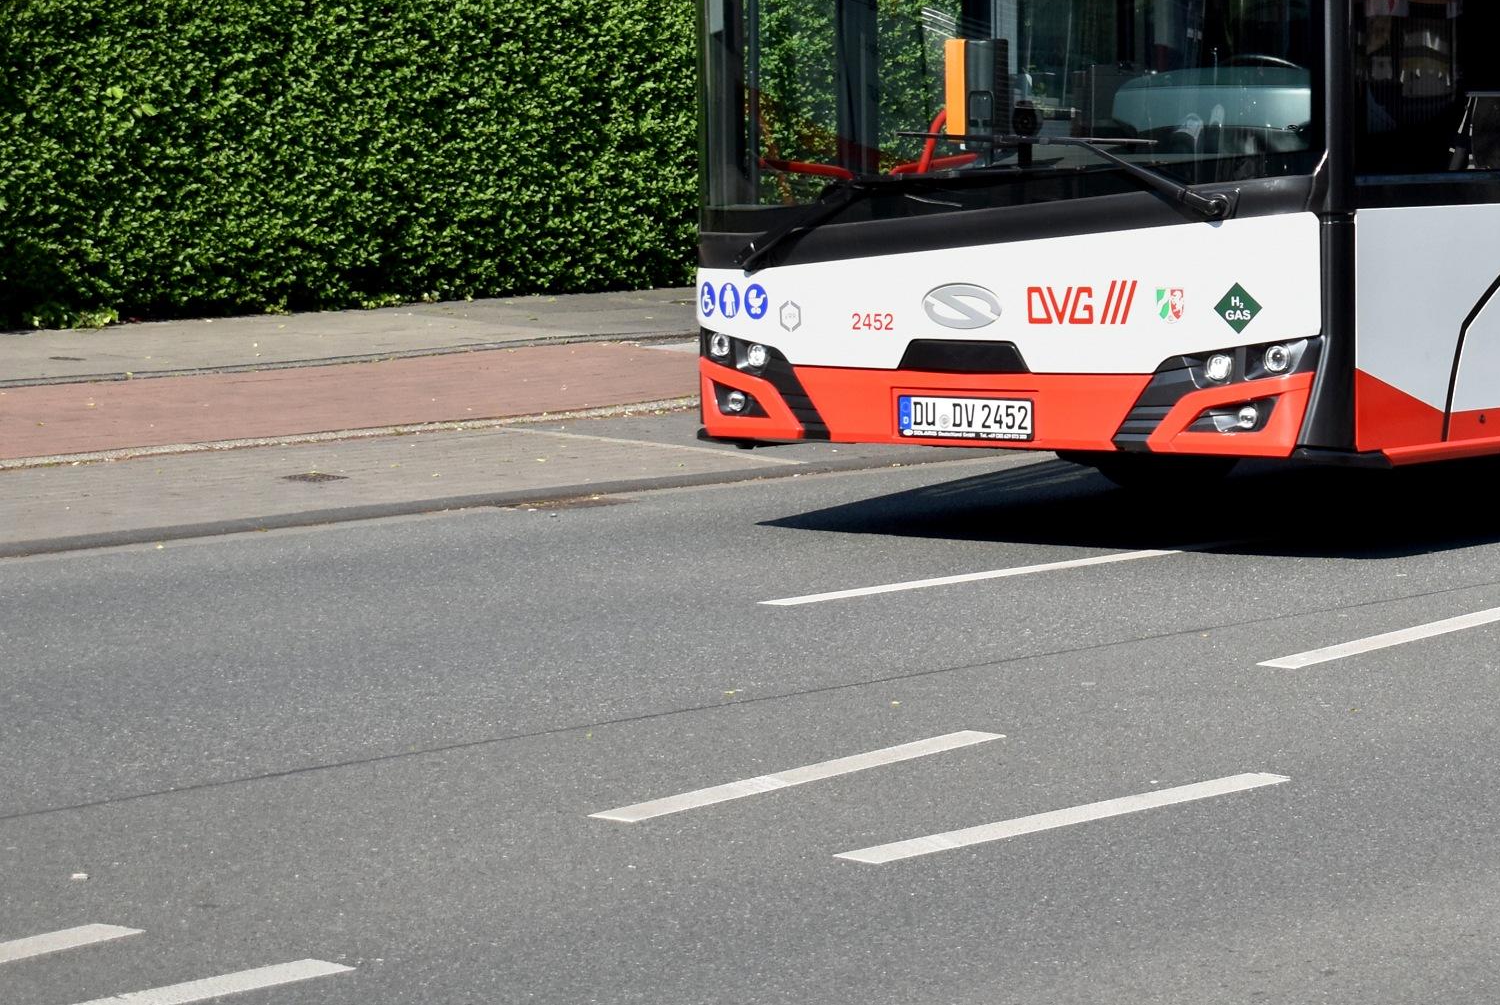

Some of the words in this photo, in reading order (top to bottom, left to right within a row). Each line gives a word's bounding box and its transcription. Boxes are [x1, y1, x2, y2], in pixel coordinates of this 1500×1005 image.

[1027, 286, 1094, 325] DVG
[1225, 310, 1251, 321] GAS
[852, 313, 895, 330] 2452
[913, 401, 936, 427] DU
[952, 402, 975, 428] DV
[981, 404, 1028, 430] 2452
